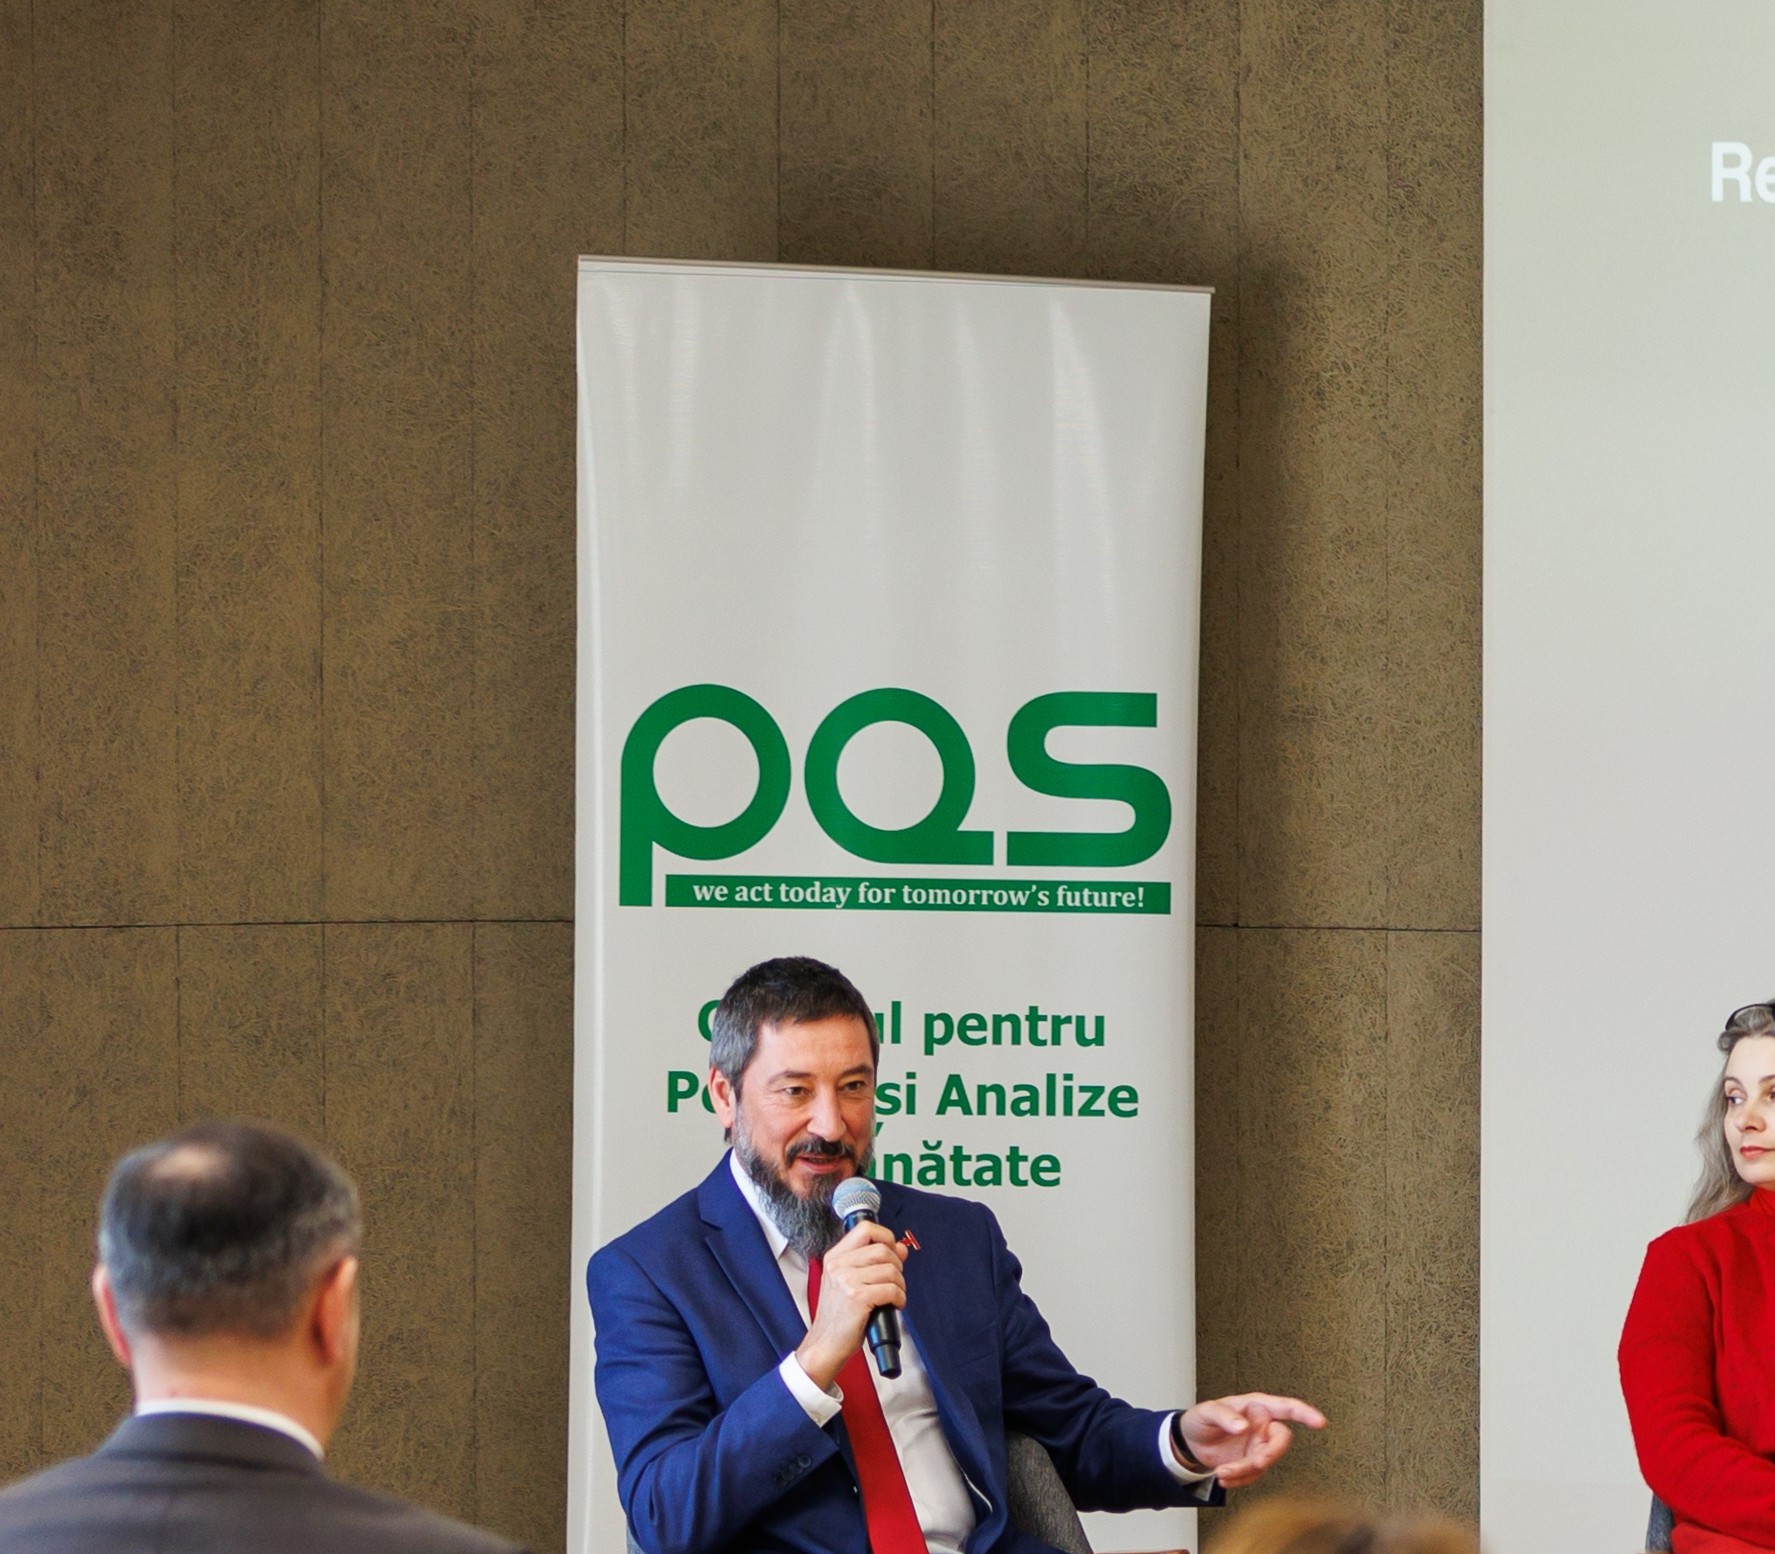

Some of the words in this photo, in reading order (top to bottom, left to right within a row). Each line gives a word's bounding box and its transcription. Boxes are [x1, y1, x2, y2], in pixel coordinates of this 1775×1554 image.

[692, 884, 729, 902] we
[734, 882, 774, 903] act
[779, 881, 853, 908] today
[858, 882, 897, 904] for
[1056, 884, 1146, 908] future!
[923, 1003, 1106, 1056] pentru
[936, 1073, 1140, 1118] Analize
[868, 1140, 1062, 1188] nătate
